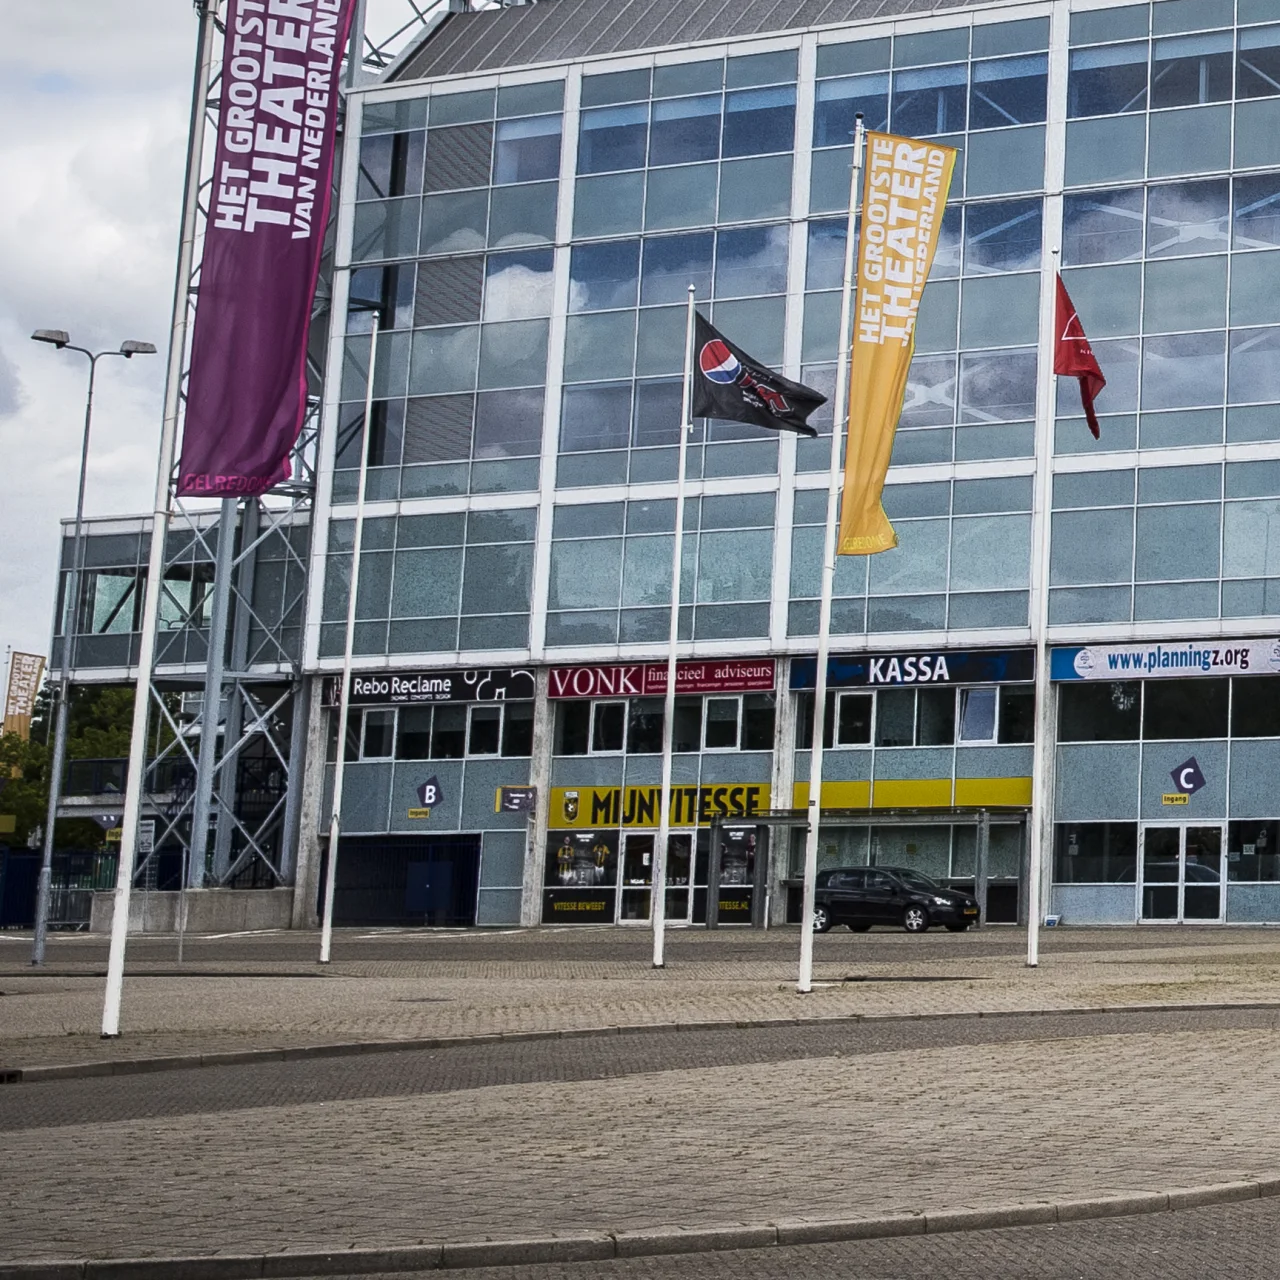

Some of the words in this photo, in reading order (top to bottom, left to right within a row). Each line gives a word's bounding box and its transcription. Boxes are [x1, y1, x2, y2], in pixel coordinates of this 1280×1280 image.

[214, 161, 250, 231] HET
[291, 176, 317, 239] VAN
[863, 138, 894, 282] GROOTSTE
[879, 143, 928, 345] THEATER
[859, 288, 882, 344] HET
[869, 656, 950, 683] KASSA
[1108, 644, 1250, 673] www.planningz.org
[14, 655, 36, 716] THEATER
[353, 677, 389, 695] Rebo
[391, 675, 452, 694] Reclame
[551, 666, 640, 696] VONK
[648, 665, 706, 682] finacieel
[714, 664, 772, 679] adviseurs
[424, 785, 436, 803] B
[1180, 768, 1195, 789] C
[591, 786, 760, 824] MIJNVITESSE
[1164, 795, 1187, 803] Ingang
[718, 900, 749, 910] ITESSE.NL
